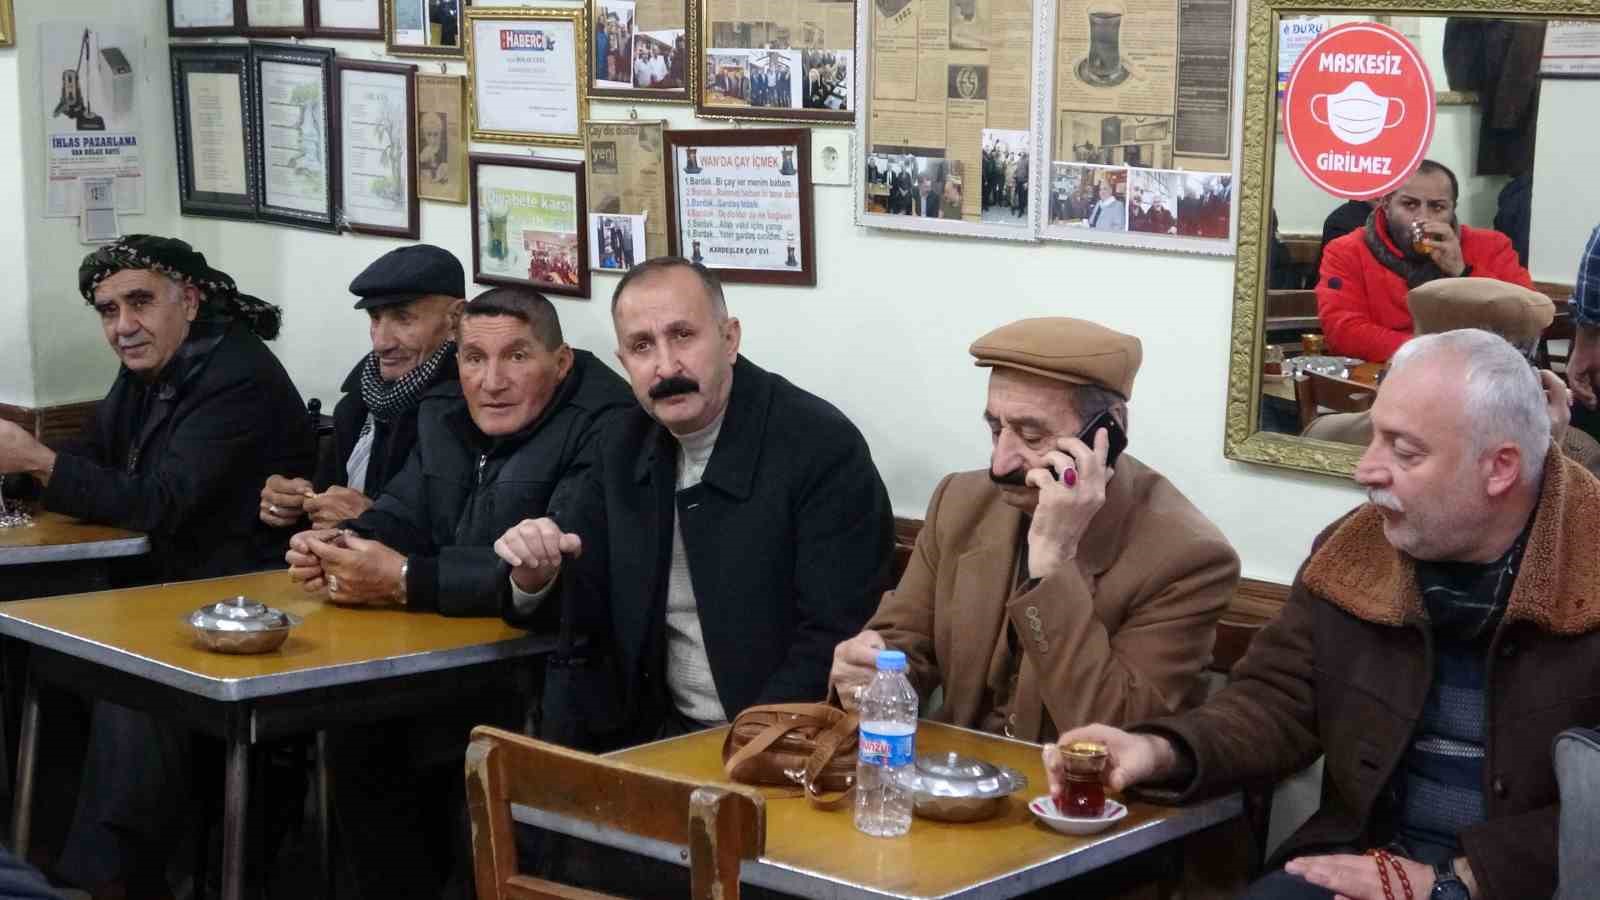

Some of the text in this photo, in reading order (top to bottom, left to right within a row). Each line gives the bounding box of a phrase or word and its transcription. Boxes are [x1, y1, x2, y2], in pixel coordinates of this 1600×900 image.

[1318, 51, 1402, 75] MASKESİZ
[83, 136, 136, 148] PAZARLAMA
[1316, 149, 1392, 175] GİRİLMEZ
